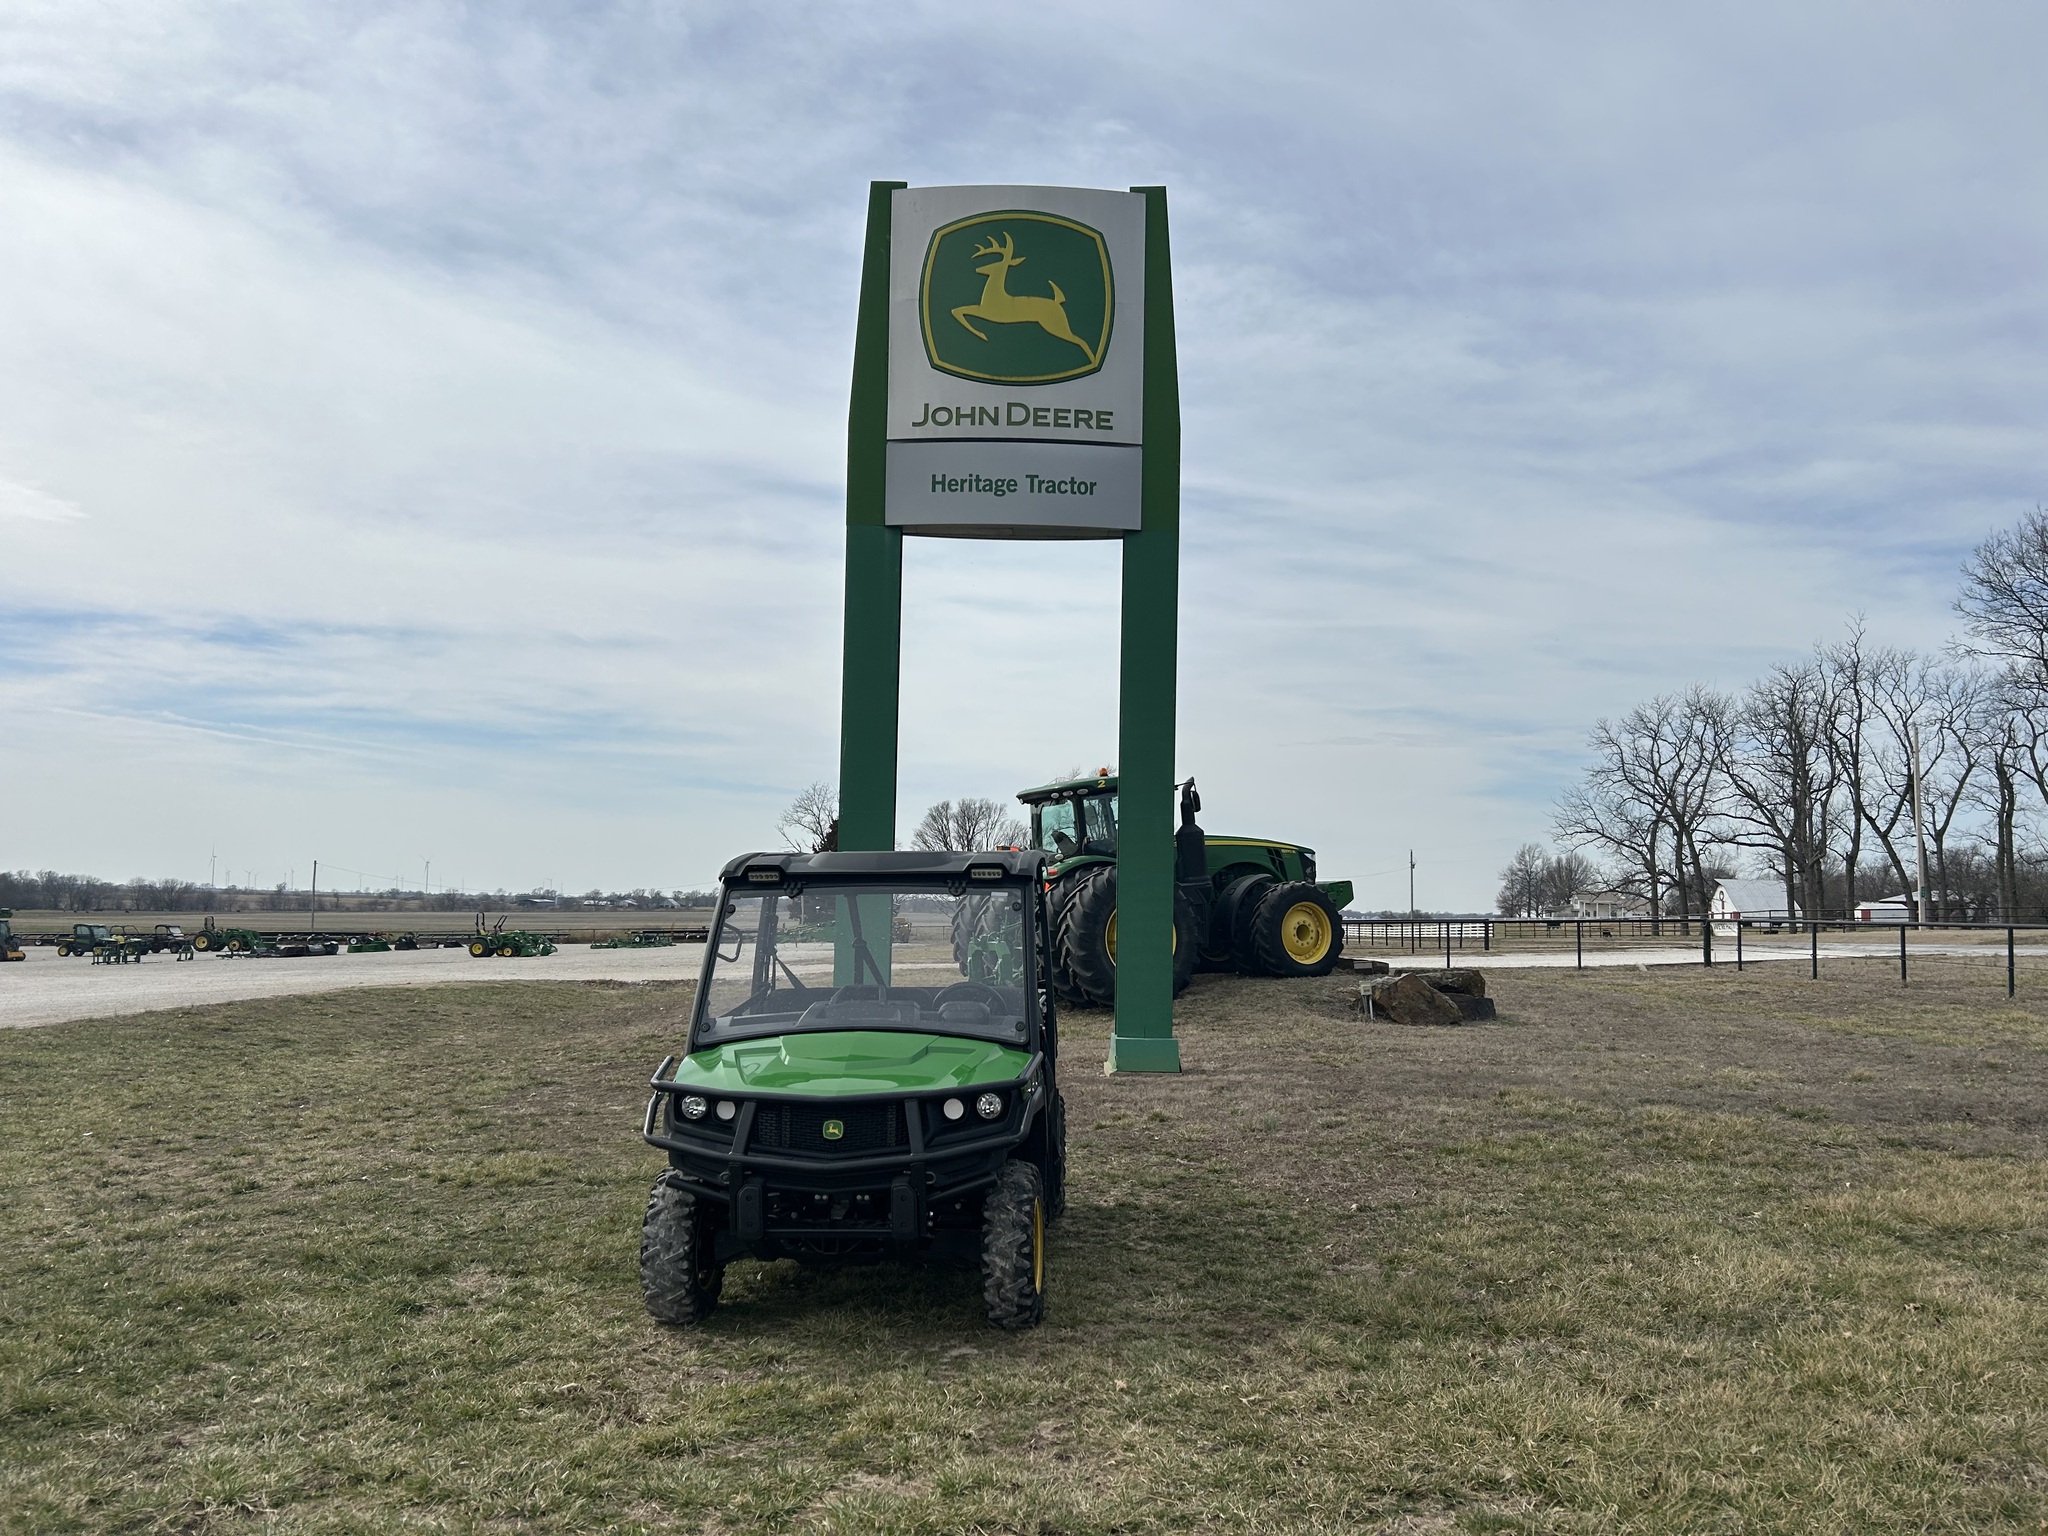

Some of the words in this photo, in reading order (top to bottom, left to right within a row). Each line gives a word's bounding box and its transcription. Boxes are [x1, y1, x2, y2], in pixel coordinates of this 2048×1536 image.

[911, 403, 999, 427] JOHN
[1006, 402, 1114, 430] DEERE
[931, 473, 1018, 497] Heritage
[1025, 474, 1097, 495] Tractor
